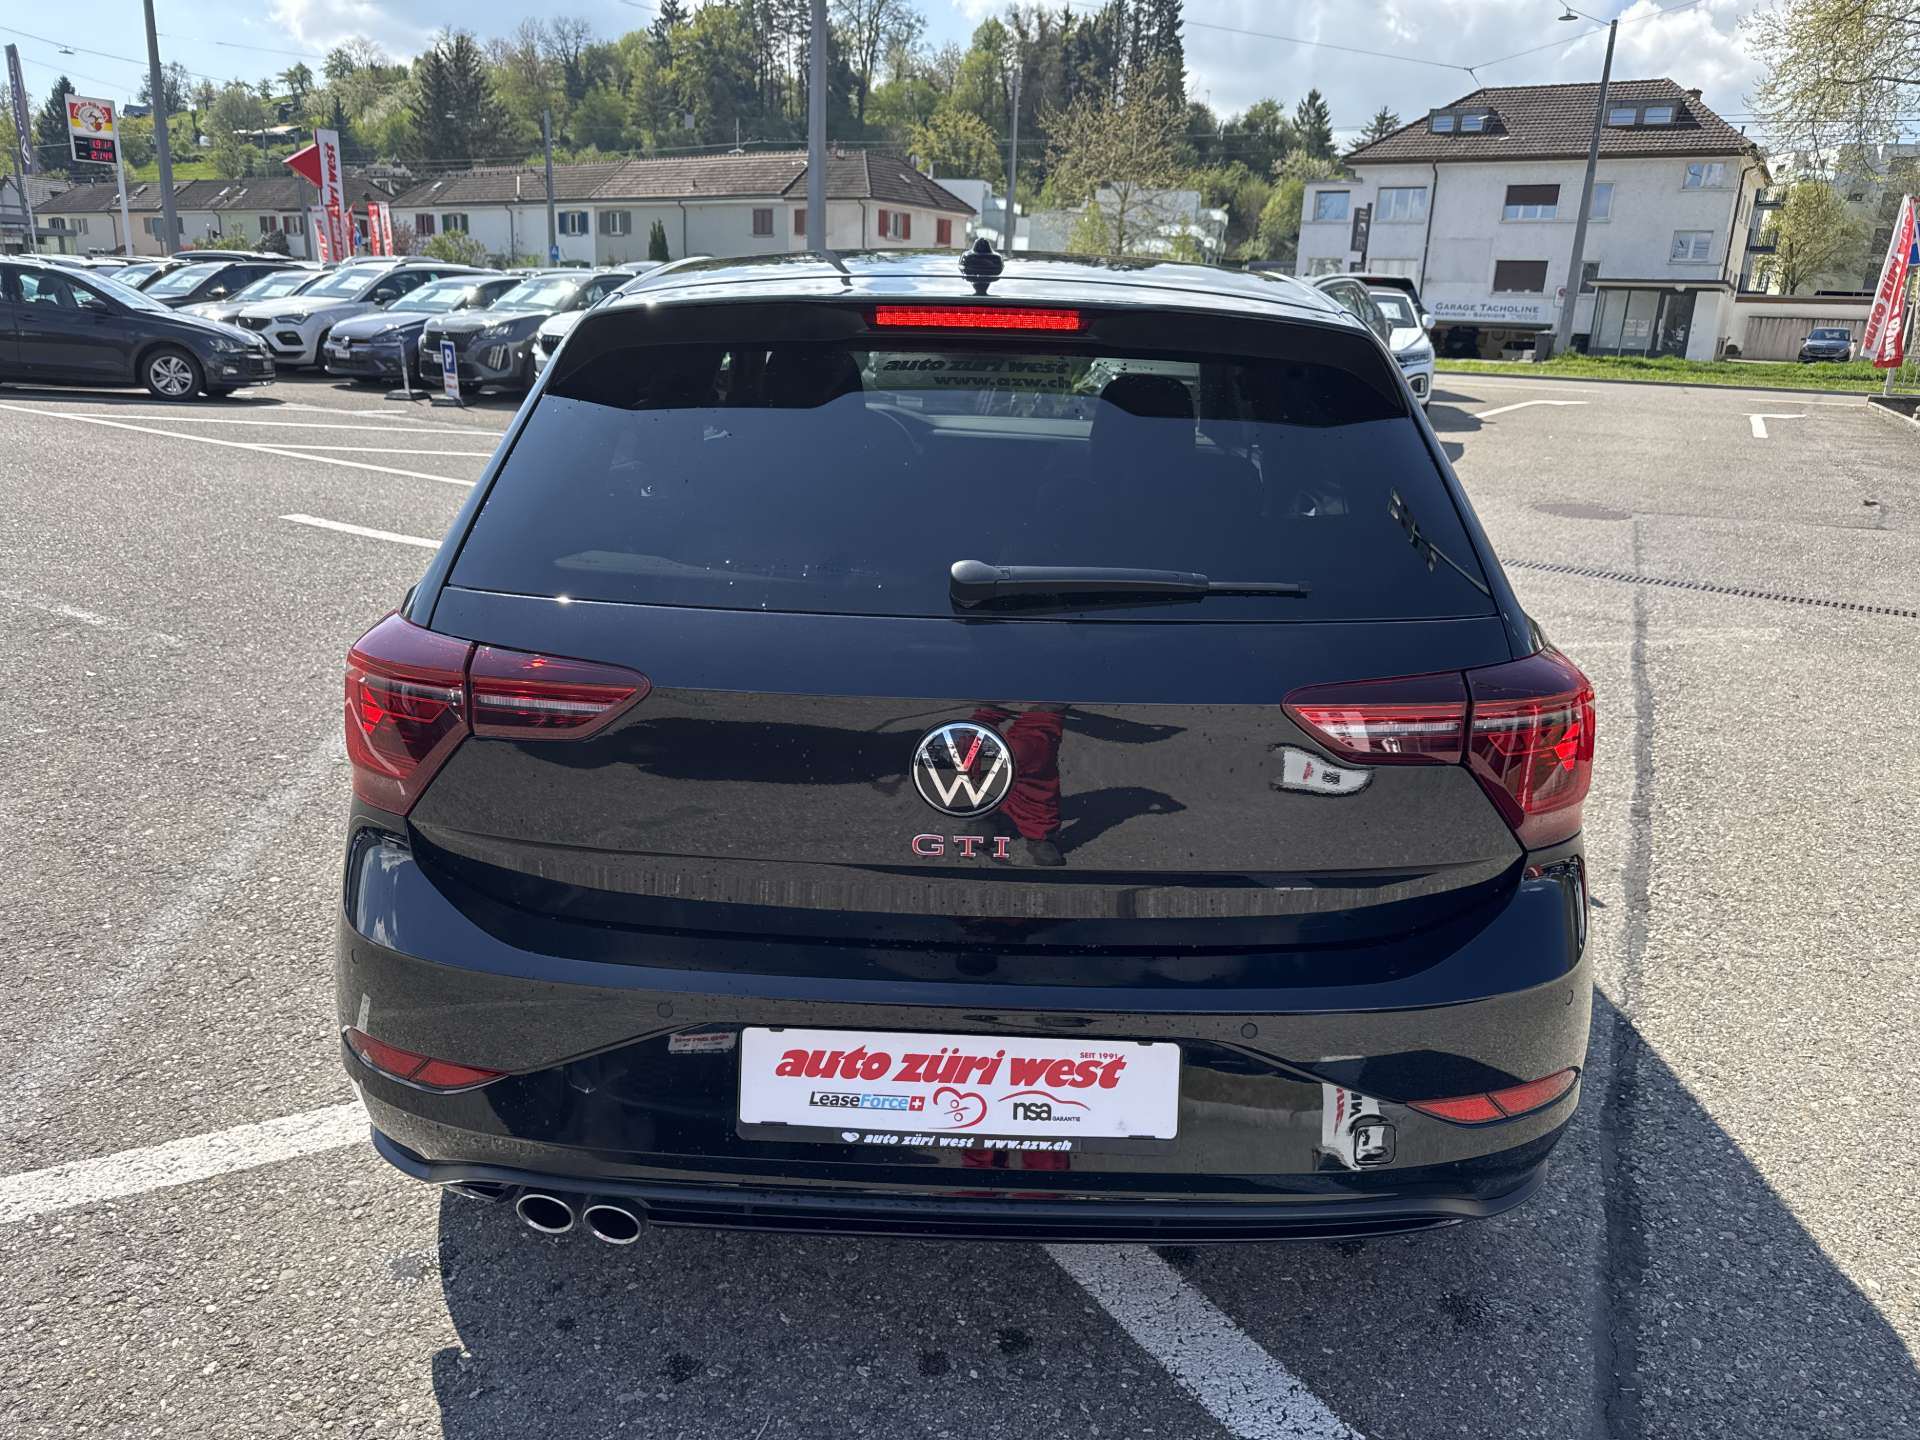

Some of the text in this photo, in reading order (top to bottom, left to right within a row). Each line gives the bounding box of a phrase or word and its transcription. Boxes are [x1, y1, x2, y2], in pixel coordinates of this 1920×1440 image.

[324, 142, 338, 182] west
[1435, 302, 1540, 314] GARAGE TACHOLINE
[1863, 302, 1886, 350] auto
[1880, 256, 1900, 304] züri
[445, 349, 452, 370] P
[883, 358, 946, 371] auto
[1008, 357, 1070, 373] west
[934, 375, 1072, 389] www.azw.ch
[912, 833, 1010, 858] GTI
[775, 1045, 1127, 1089] auto züri west
[809, 1091, 908, 1109] LeaseForce
[1013, 1102, 1052, 1121] nsa
[863, 1133, 1073, 1152] auto züri west www.azw.ch
